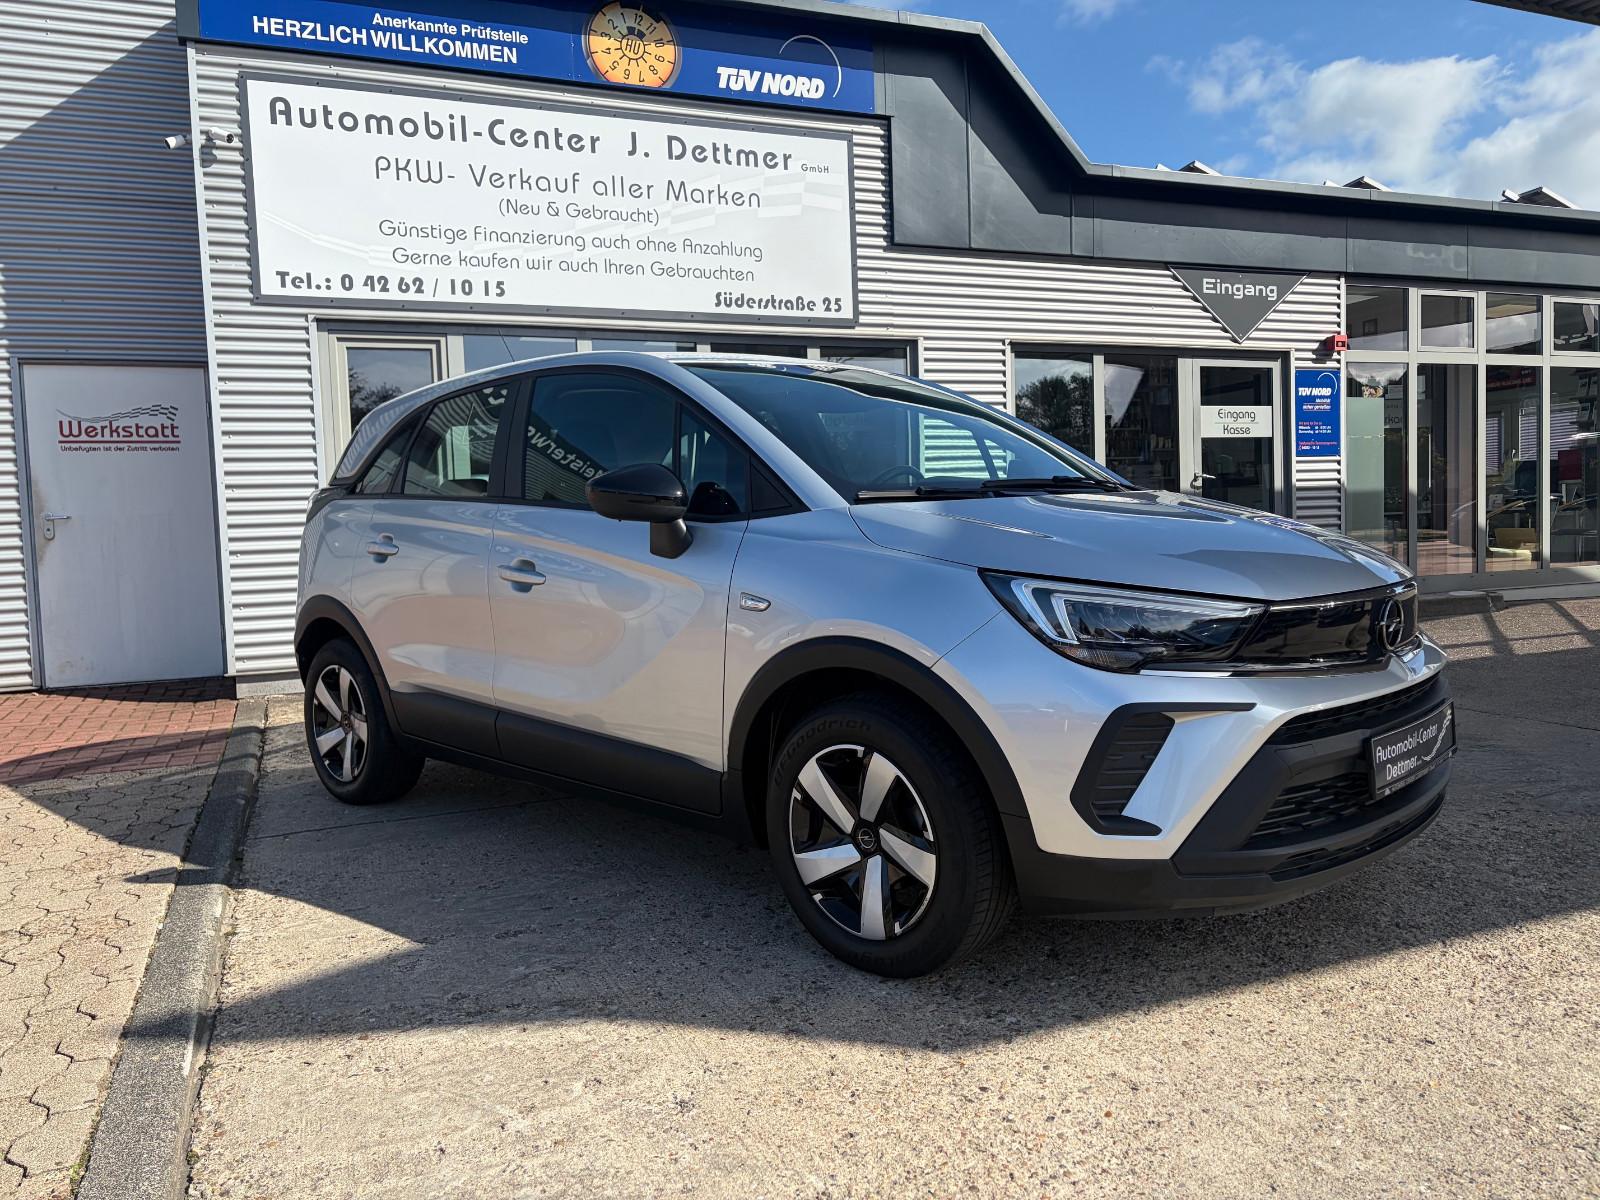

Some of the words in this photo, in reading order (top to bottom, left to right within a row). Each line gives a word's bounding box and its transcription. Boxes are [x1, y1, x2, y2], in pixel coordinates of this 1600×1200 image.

[372, 12, 458, 36] Anerkannte
[461, 24, 529, 45] Prüfstelle
[607, 18, 619, 31] 2
[634, 13, 644, 27] 12
[252, 15, 368, 46] HERZLICH
[369, 30, 518, 64] WILLKOMMEN
[600, 31, 612, 41] 3
[624, 38, 641, 56] HU
[601, 47, 612, 55] 4
[609, 60, 620, 71] 5
[648, 64, 659, 76] 8
[716, 66, 762, 92] TÜV
[761, 75, 825, 99] NORD
[269, 96, 601, 154] Automobil-Center
[627, 131, 651, 159] J.
[667, 135, 793, 171] Dettmer
[800, 163, 830, 174] GmbH
[374, 155, 456, 185] PKW-
[468, 163, 580, 194] Verkauf
[592, 175, 655, 200] aller
[666, 179, 762, 209] Marken
[498, 198, 540, 217] (Neu
[546, 202, 560, 217] &
[565, 202, 660, 227] Gebraucht)
[378, 219, 468, 244] Günstige
[473, 225, 586, 251] Finanzierung
[591, 233, 631, 250] auch
[636, 236, 677, 253] ohne
[682, 238, 763, 263] Anzahlung
[392, 247, 453, 266] Gerne
[458, 250, 520, 270] kaufen
[525, 256, 552, 271] wir
[558, 257, 598, 274] auch
[603, 258, 645, 277] Ihren
[650, 261, 755, 282] Gebrauchten
[275, 270, 332, 291] Tel.:
[340, 273, 354, 291] 0
[362, 275, 390, 293] 42
[397, 276, 425, 294] 62
[432, 277, 439, 298] /
[1202, 277, 1278, 301] Eingang
[714, 291, 816, 313] Süderstraße
[822, 296, 843, 313] 25
[1311, 387, 1332, 396] NORD
[1217, 408, 1256, 422] Eingang
[58, 420, 180, 438] Werkstatt
[1223, 424, 1251, 435] Kasse
[60, 445, 101, 453] Unbefugten
[1376, 723, 1438, 764] Automobil-Center
[1386, 755, 1418, 781] Dettmer
